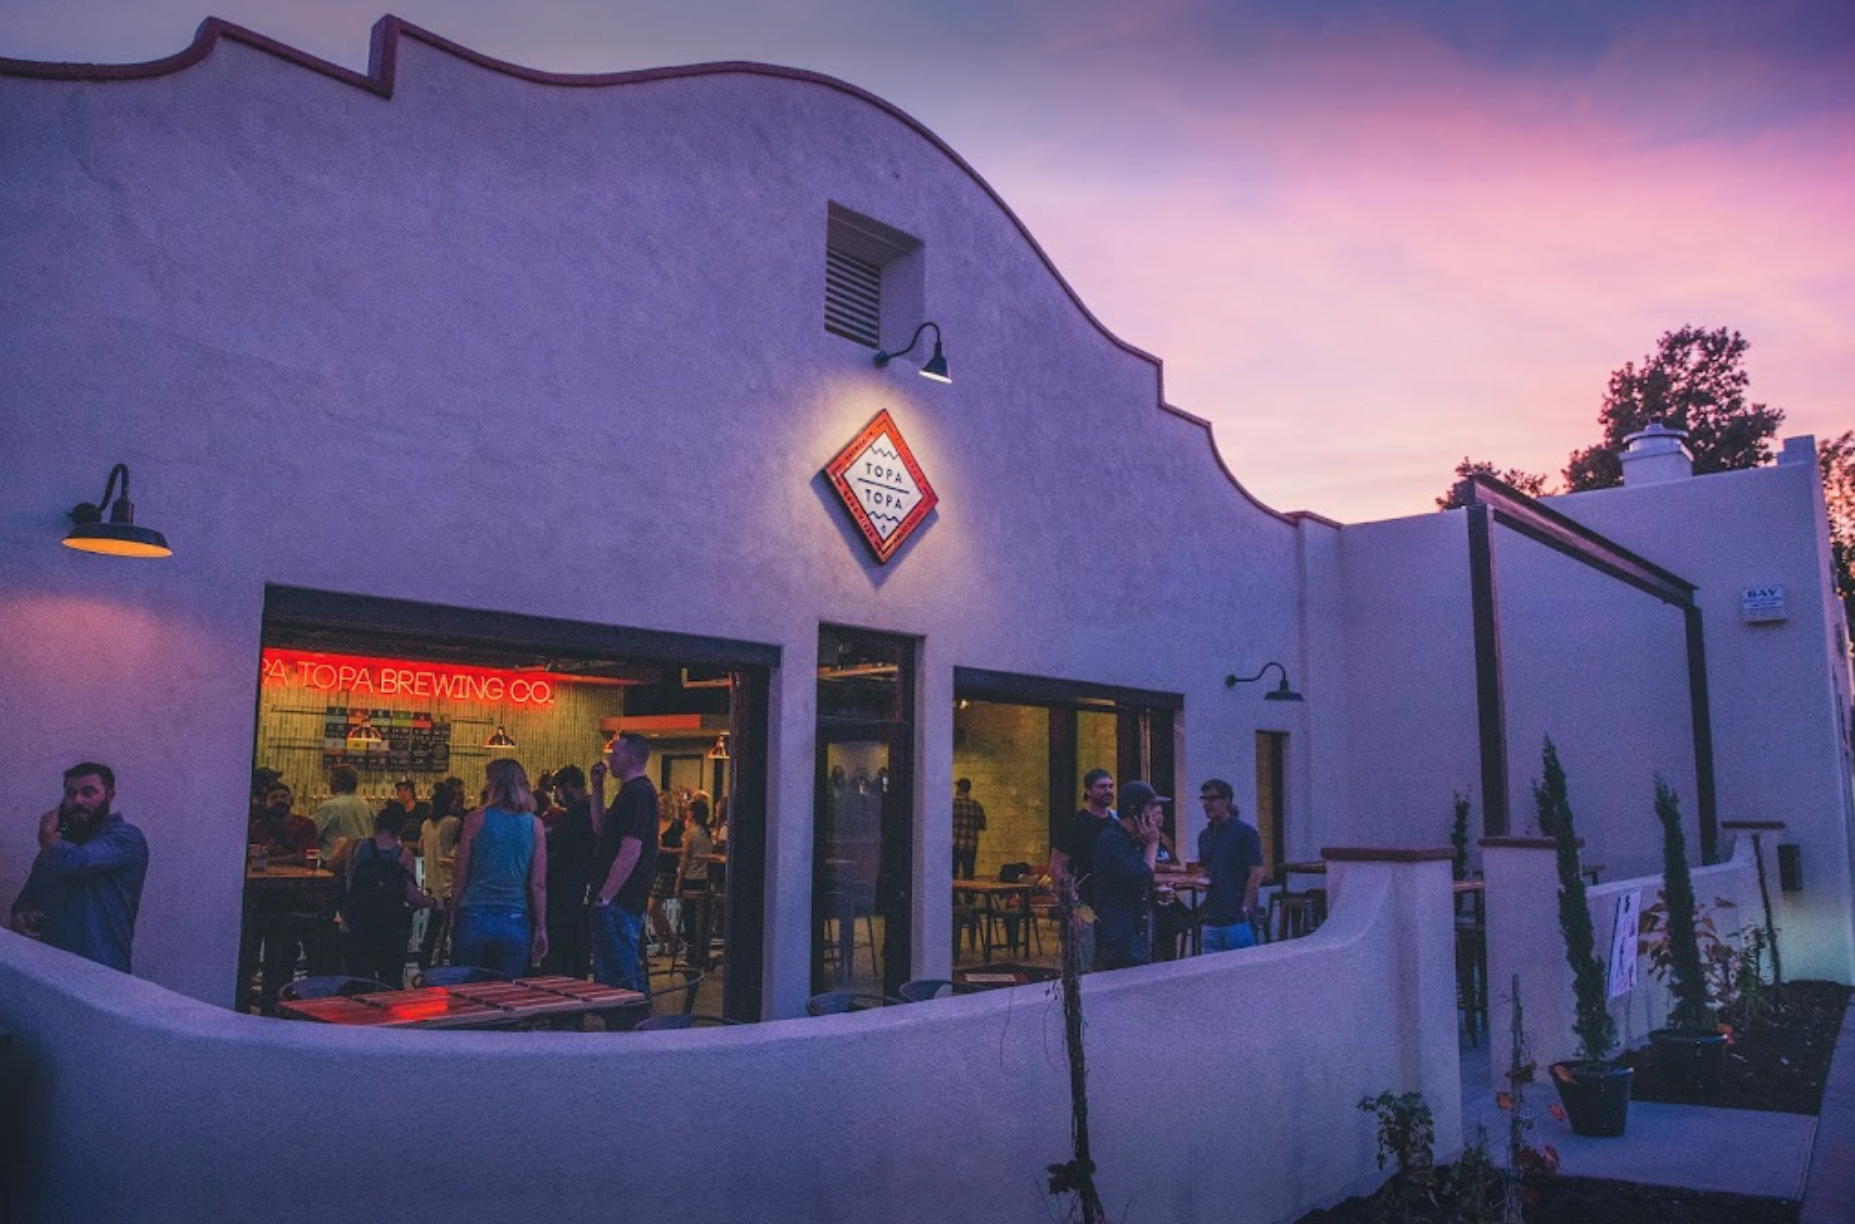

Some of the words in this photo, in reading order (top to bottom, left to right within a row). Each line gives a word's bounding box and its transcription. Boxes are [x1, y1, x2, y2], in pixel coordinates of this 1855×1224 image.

[865, 462, 902, 484] TOPA
[865, 489, 902, 510] TOPA
[296, 660, 373, 692] TOPA
[380, 668, 504, 699] BREWING
[510, 679, 555, 704] CO.
